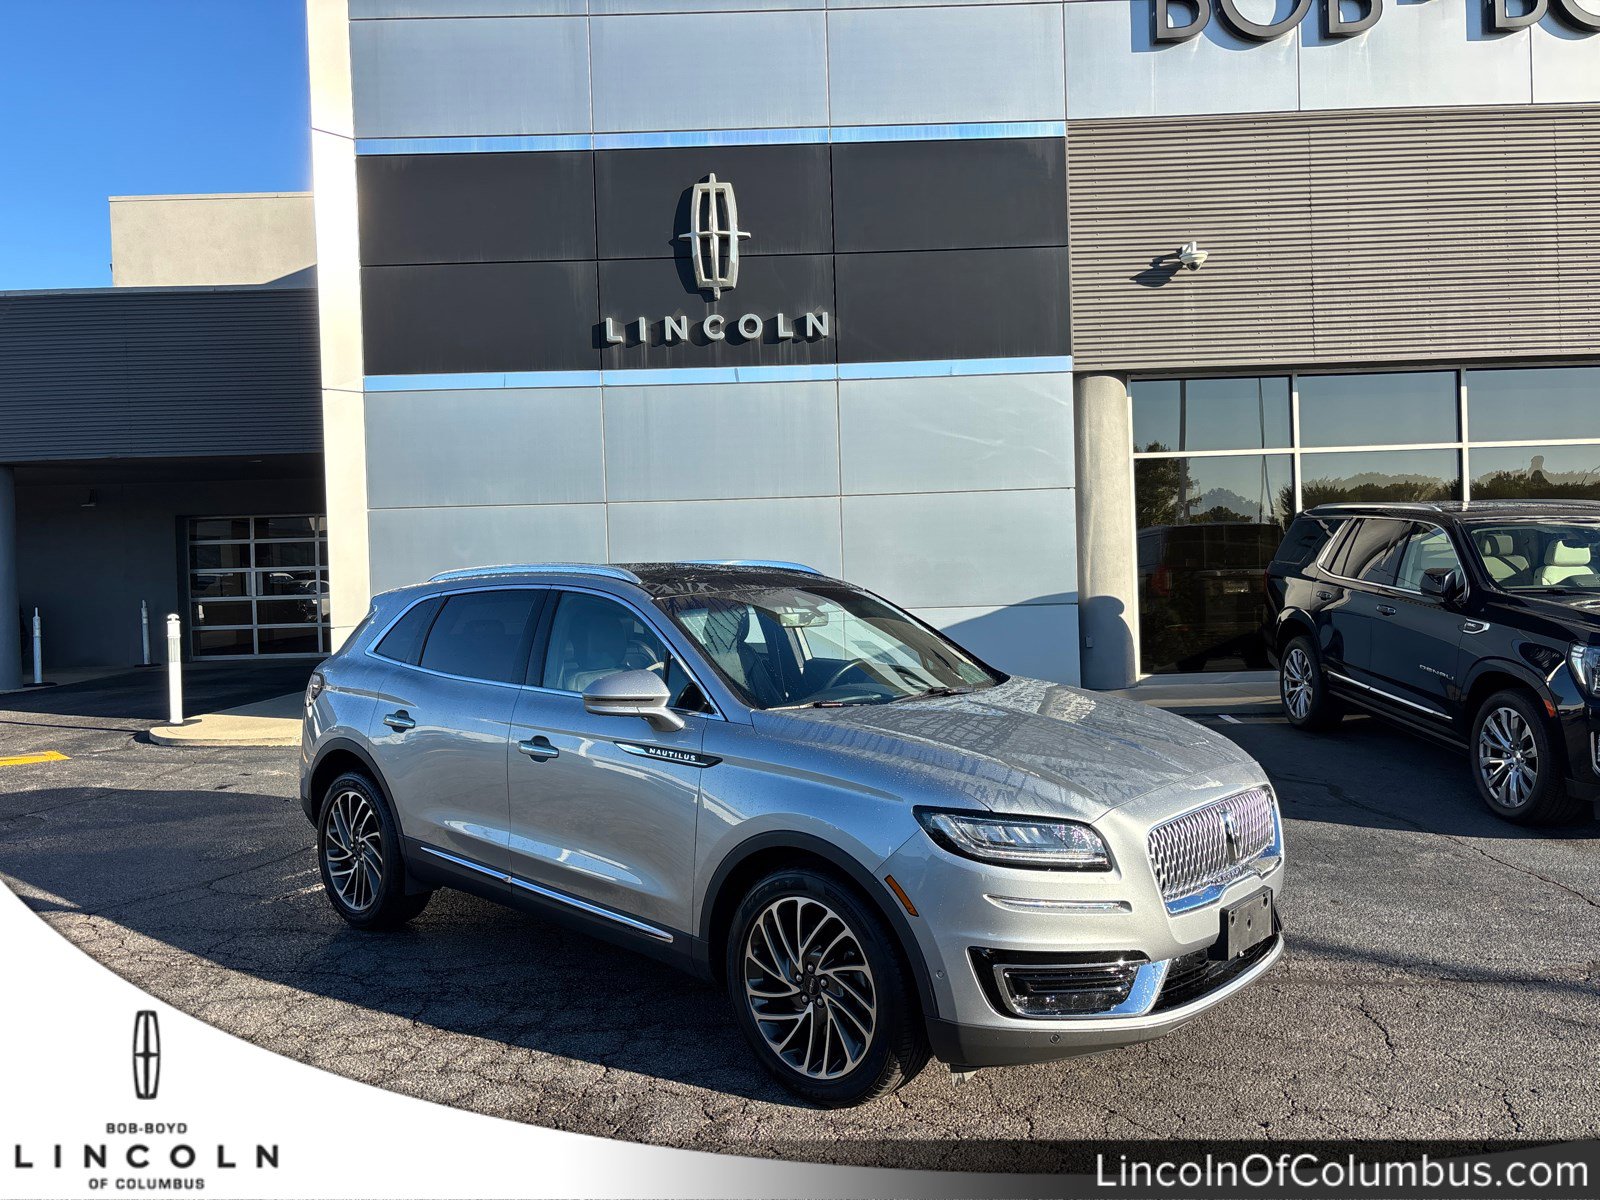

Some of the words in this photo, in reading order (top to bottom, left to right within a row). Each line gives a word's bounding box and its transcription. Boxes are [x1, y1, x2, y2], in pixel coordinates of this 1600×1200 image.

[605, 311, 829, 343] LINCOLN
[1419, 664, 1454, 680] DENALI
[649, 748, 696, 761] NAUTILUS
